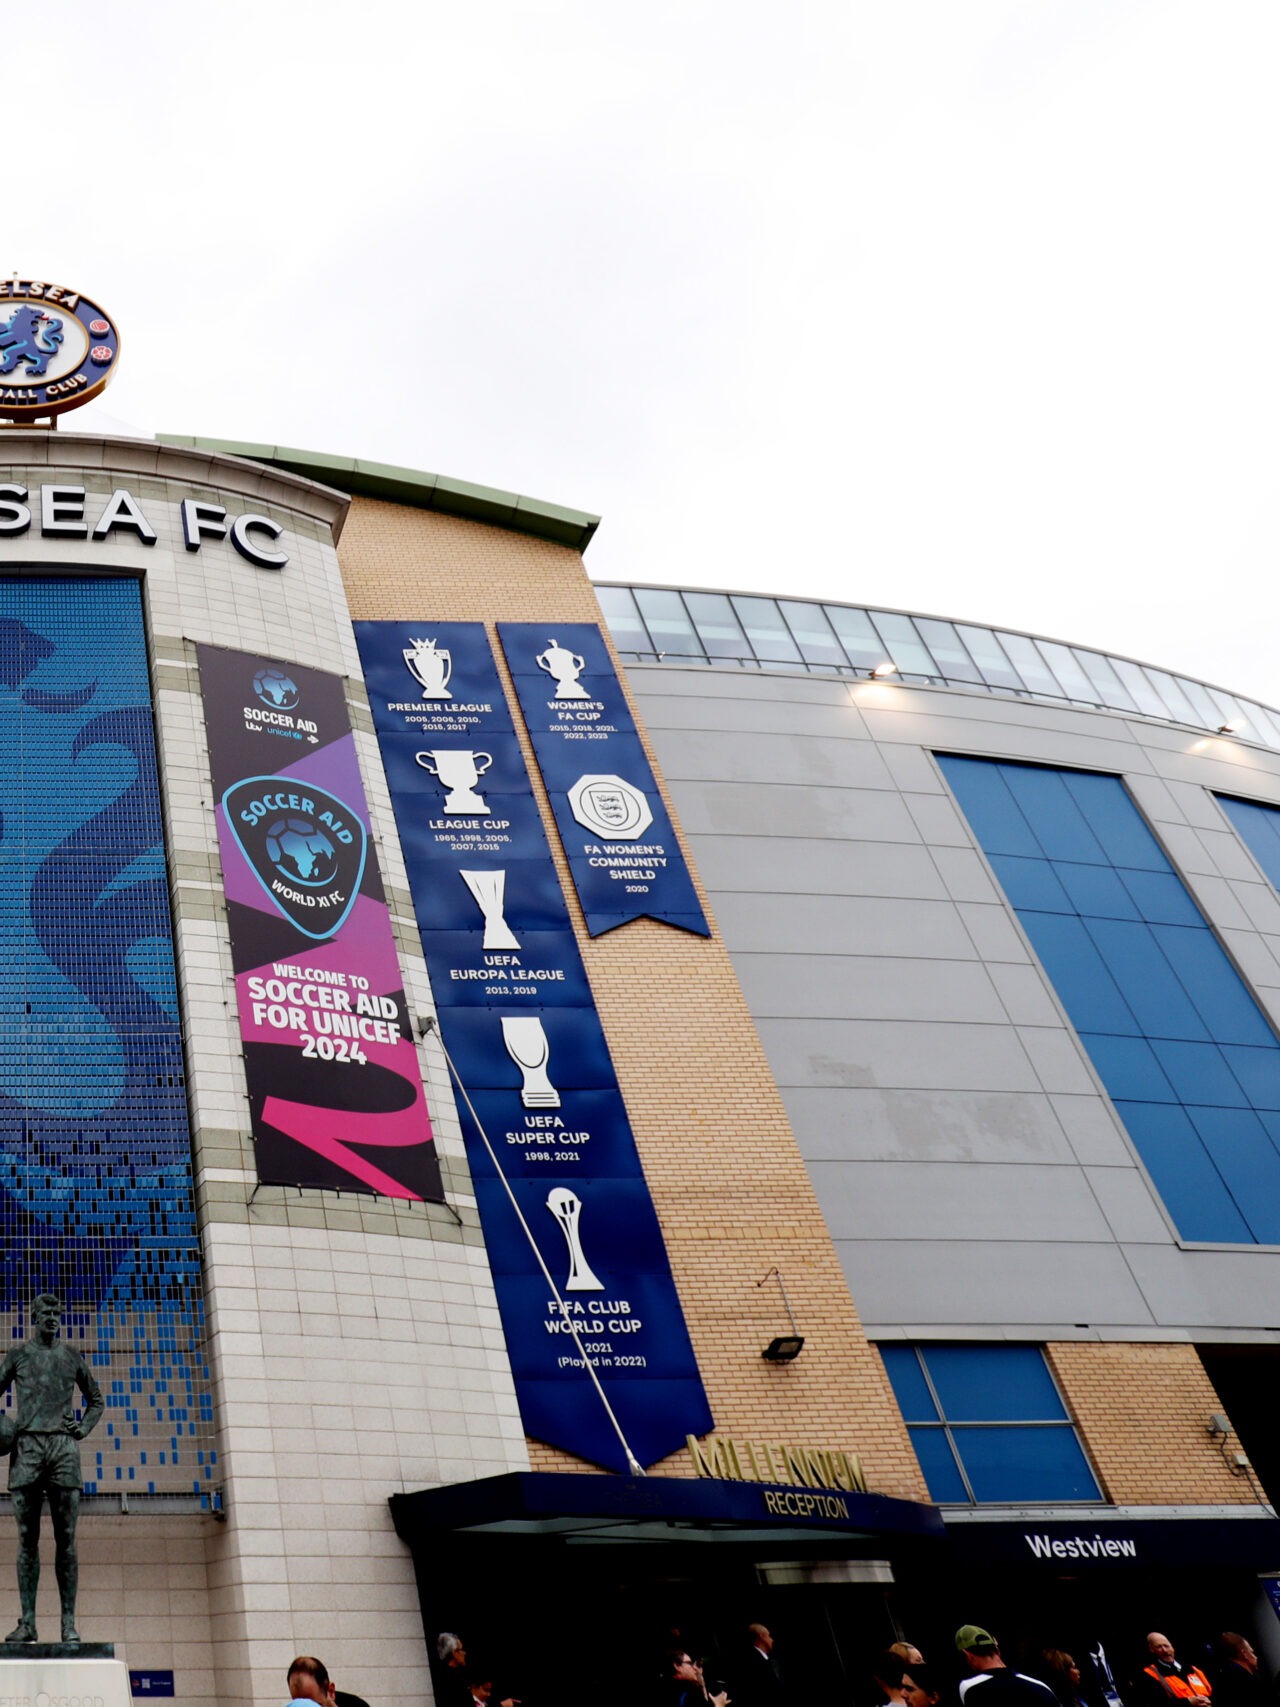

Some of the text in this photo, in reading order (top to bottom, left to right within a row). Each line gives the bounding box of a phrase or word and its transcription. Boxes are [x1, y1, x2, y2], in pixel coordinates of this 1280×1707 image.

[46, 374, 87, 395] CLUB
[180, 497, 290, 569] FC
[388, 703, 492, 713] PREMIER LEAGUE
[547, 701, 605, 711] WOMEN'S
[243, 707, 318, 734] SOCCER AID
[558, 712, 601, 721] FA CUP
[267, 727, 292, 738] unicef
[240, 793, 353, 844] SOCCER AID
[429, 820, 510, 830] LEAGUE CUP
[584, 845, 665, 855] FA WOMEN'S
[589, 857, 667, 867] COMMUNITY
[609, 870, 656, 880] SHIELD
[271, 879, 345, 908] WORLD XI FC
[625, 885, 649, 893] 2020
[484, 956, 521, 966] UEFA
[272, 963, 369, 991] WELCOME TO
[450, 970, 565, 980] EUROPA LEAGUE
[485, 986, 537, 995] 2013, 2019
[247, 976, 399, 1020] SOCCER AID
[252, 1002, 401, 1045] FOR UNICEF
[299, 1033, 368, 1065] 2024
[524, 1116, 565, 1128] UEFA
[505, 1132, 590, 1144] SUPER CUP
[524, 1151, 580, 1162] 1998, 2021
[588, 1301, 631, 1314] CLUB
[544, 1320, 642, 1333] WORLD CUP
[585, 1343, 613, 1353] 2021
[601, 1356, 612, 1366] in
[613, 1355, 647, 1368] 2022)
[686, 1434, 867, 1493] MILLENNIUM
[764, 1491, 850, 1519] RECEPTION
[1024, 1534, 1137, 1558] Westview
